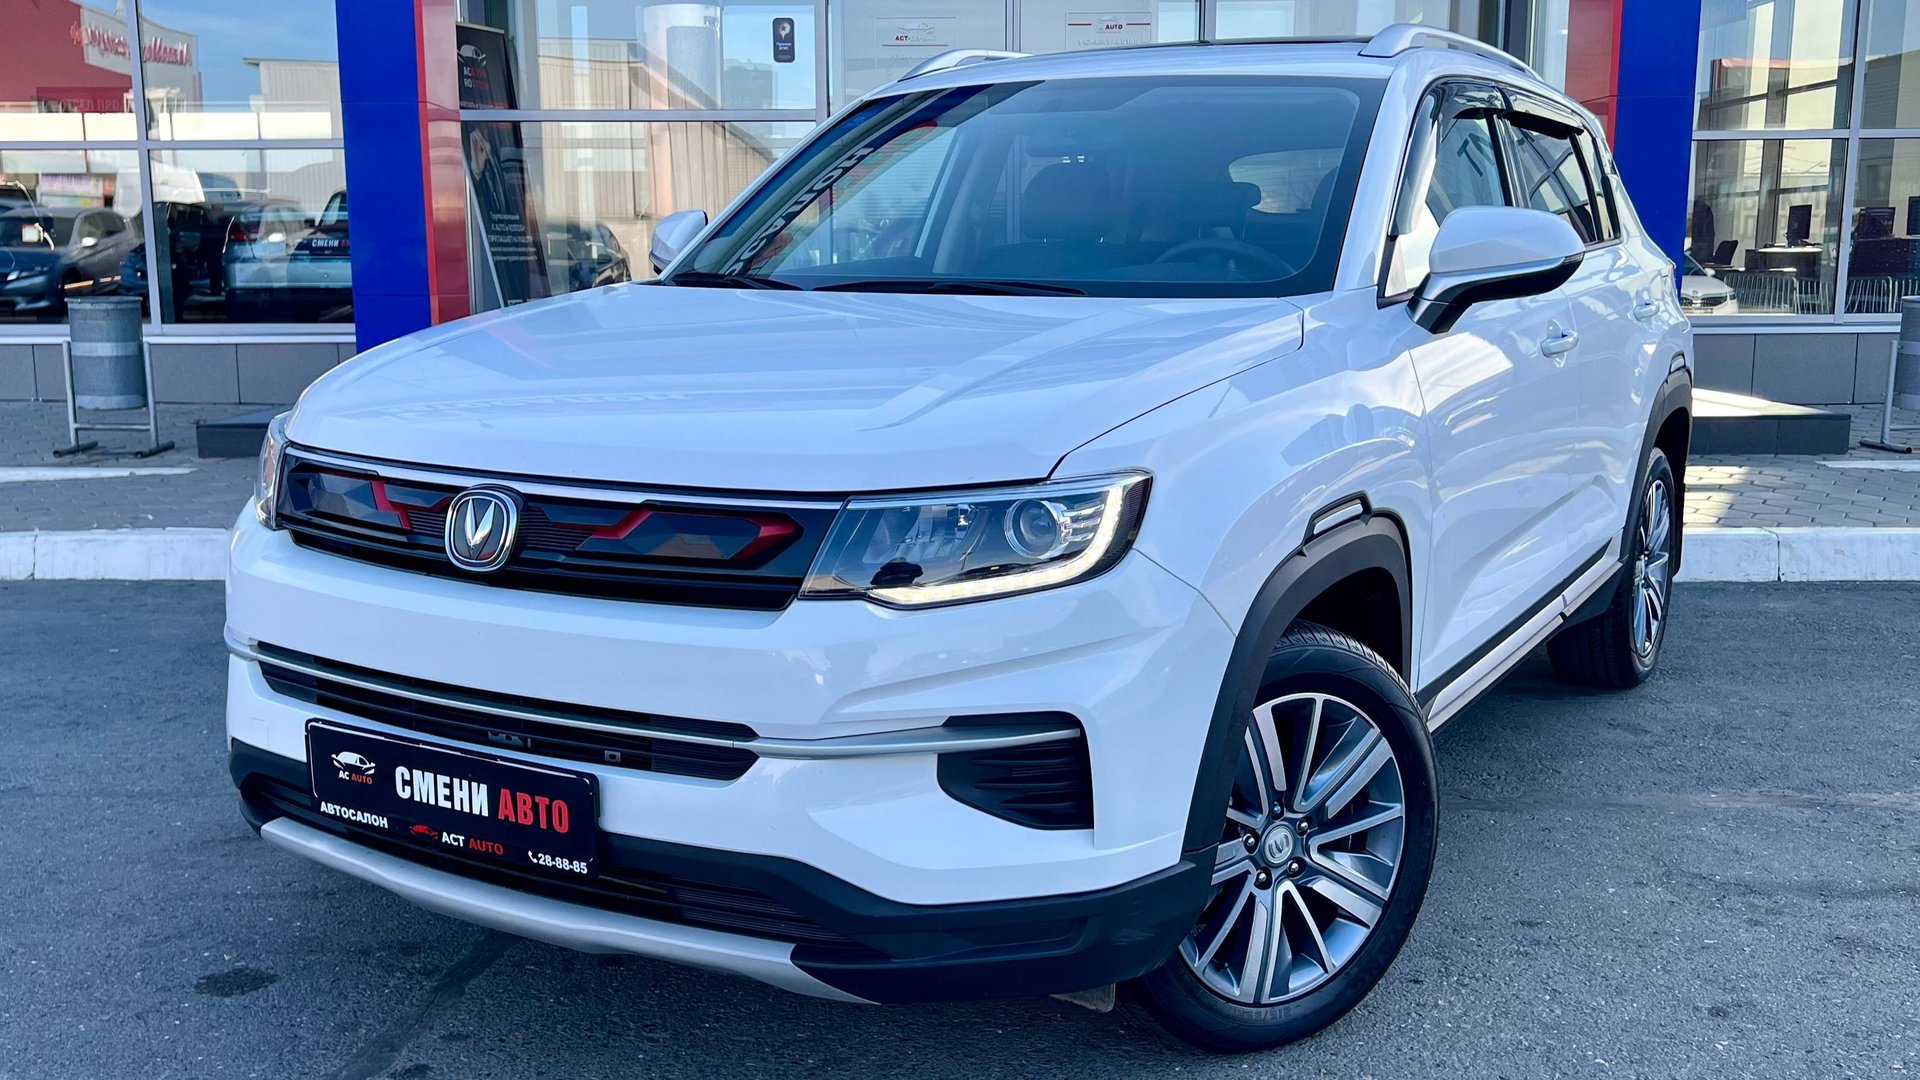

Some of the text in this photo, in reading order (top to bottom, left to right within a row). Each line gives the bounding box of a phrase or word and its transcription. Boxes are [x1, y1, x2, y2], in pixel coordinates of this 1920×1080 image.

[339, 770, 373, 785] AC AUTO
[395, 765, 569, 834] СМЕНИ АВТО
[320, 800, 389, 829] АВТОСАЛОН
[468, 838, 504, 855] AUTO
[537, 853, 588, 875] 28-88-85
